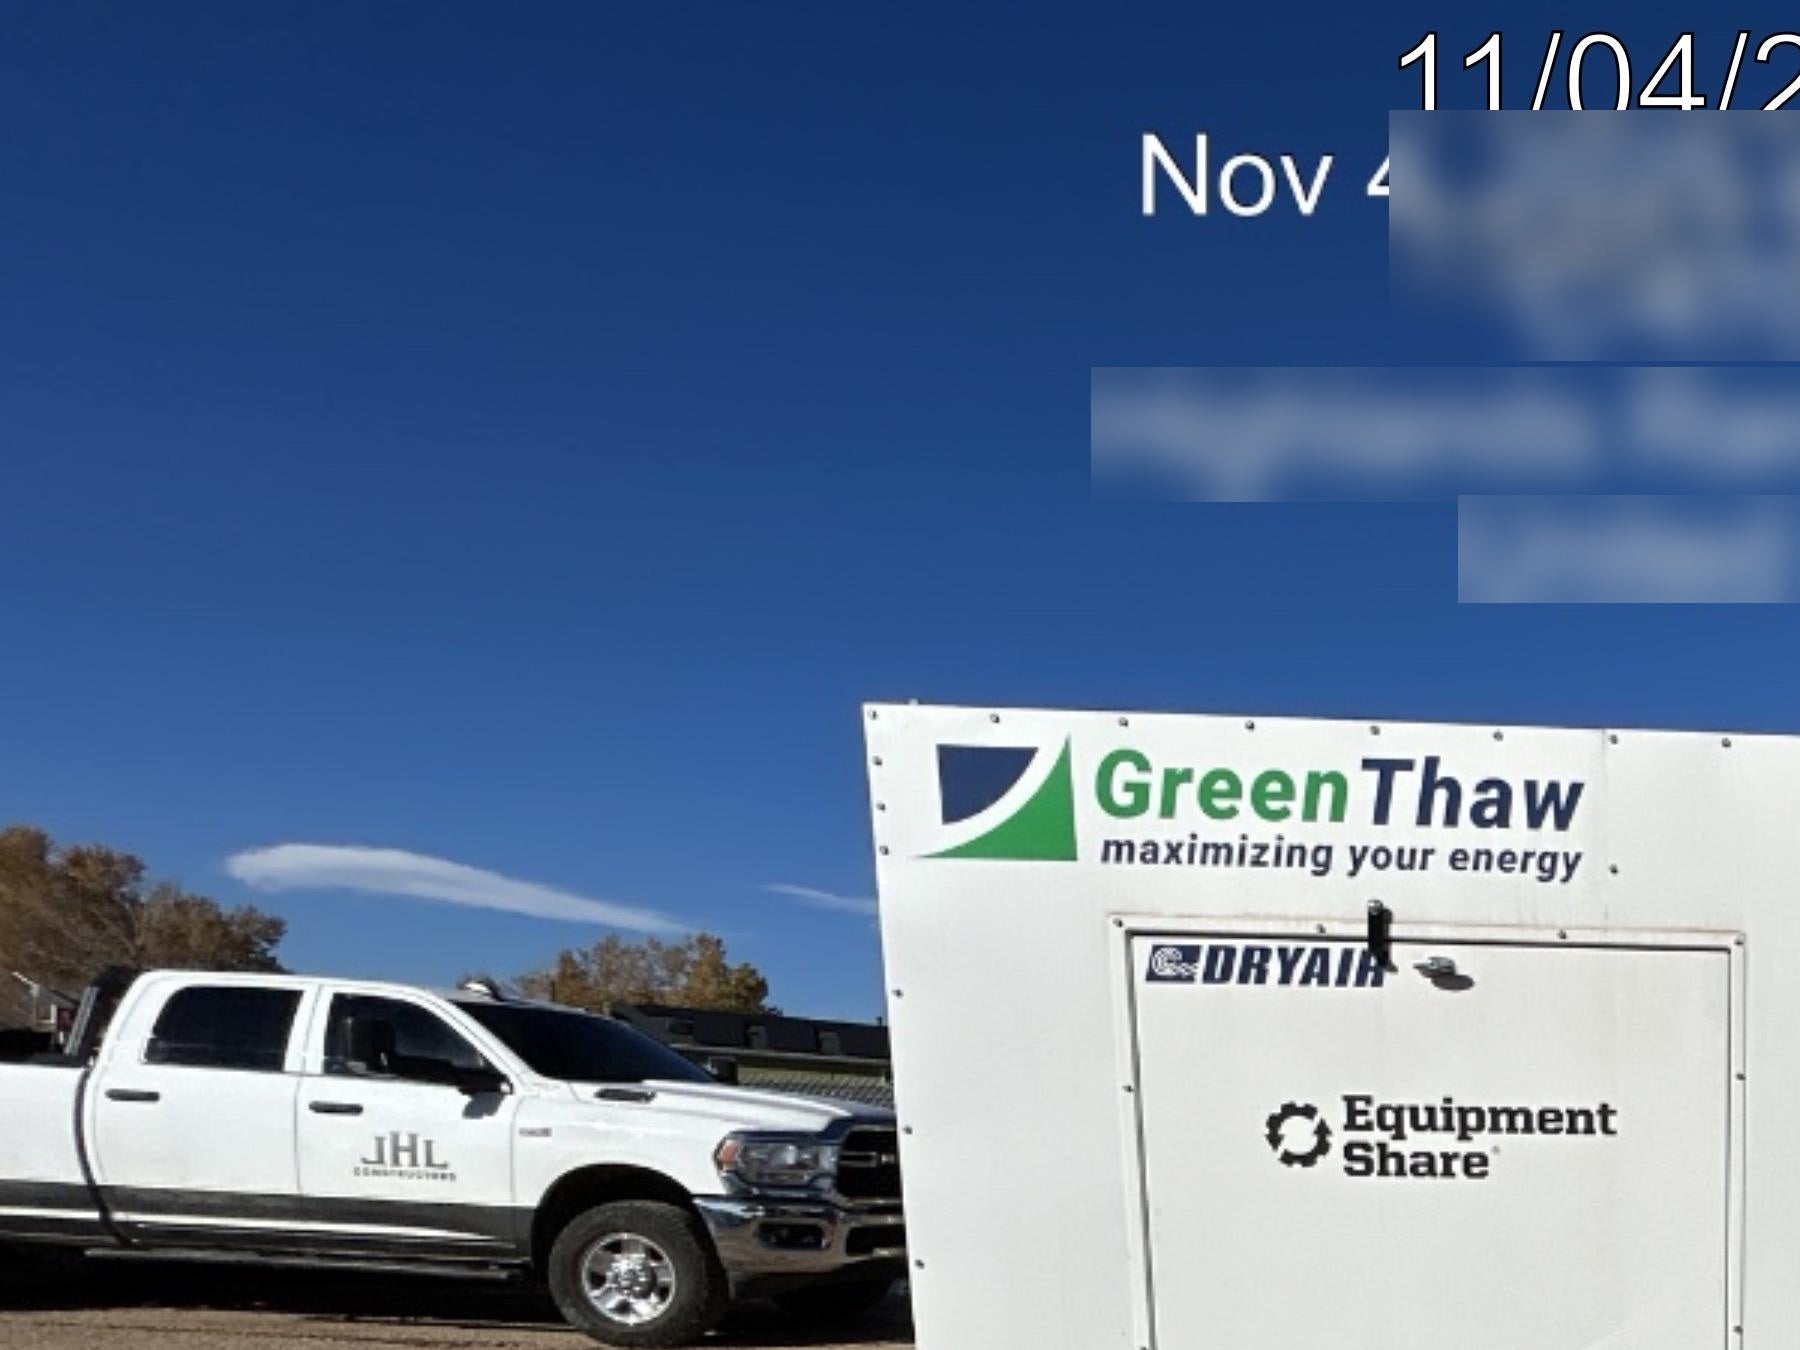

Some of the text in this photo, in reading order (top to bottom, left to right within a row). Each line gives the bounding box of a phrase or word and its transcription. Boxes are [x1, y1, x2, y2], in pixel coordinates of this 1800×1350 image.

[1100, 832, 1584, 883] maximizing your energy
[1201, 944, 1386, 987] DRYAIR
[1341, 1094, 1618, 1141] Equipment
[361, 1131, 449, 1169] JHL
[1342, 1141, 1490, 1180] Share
